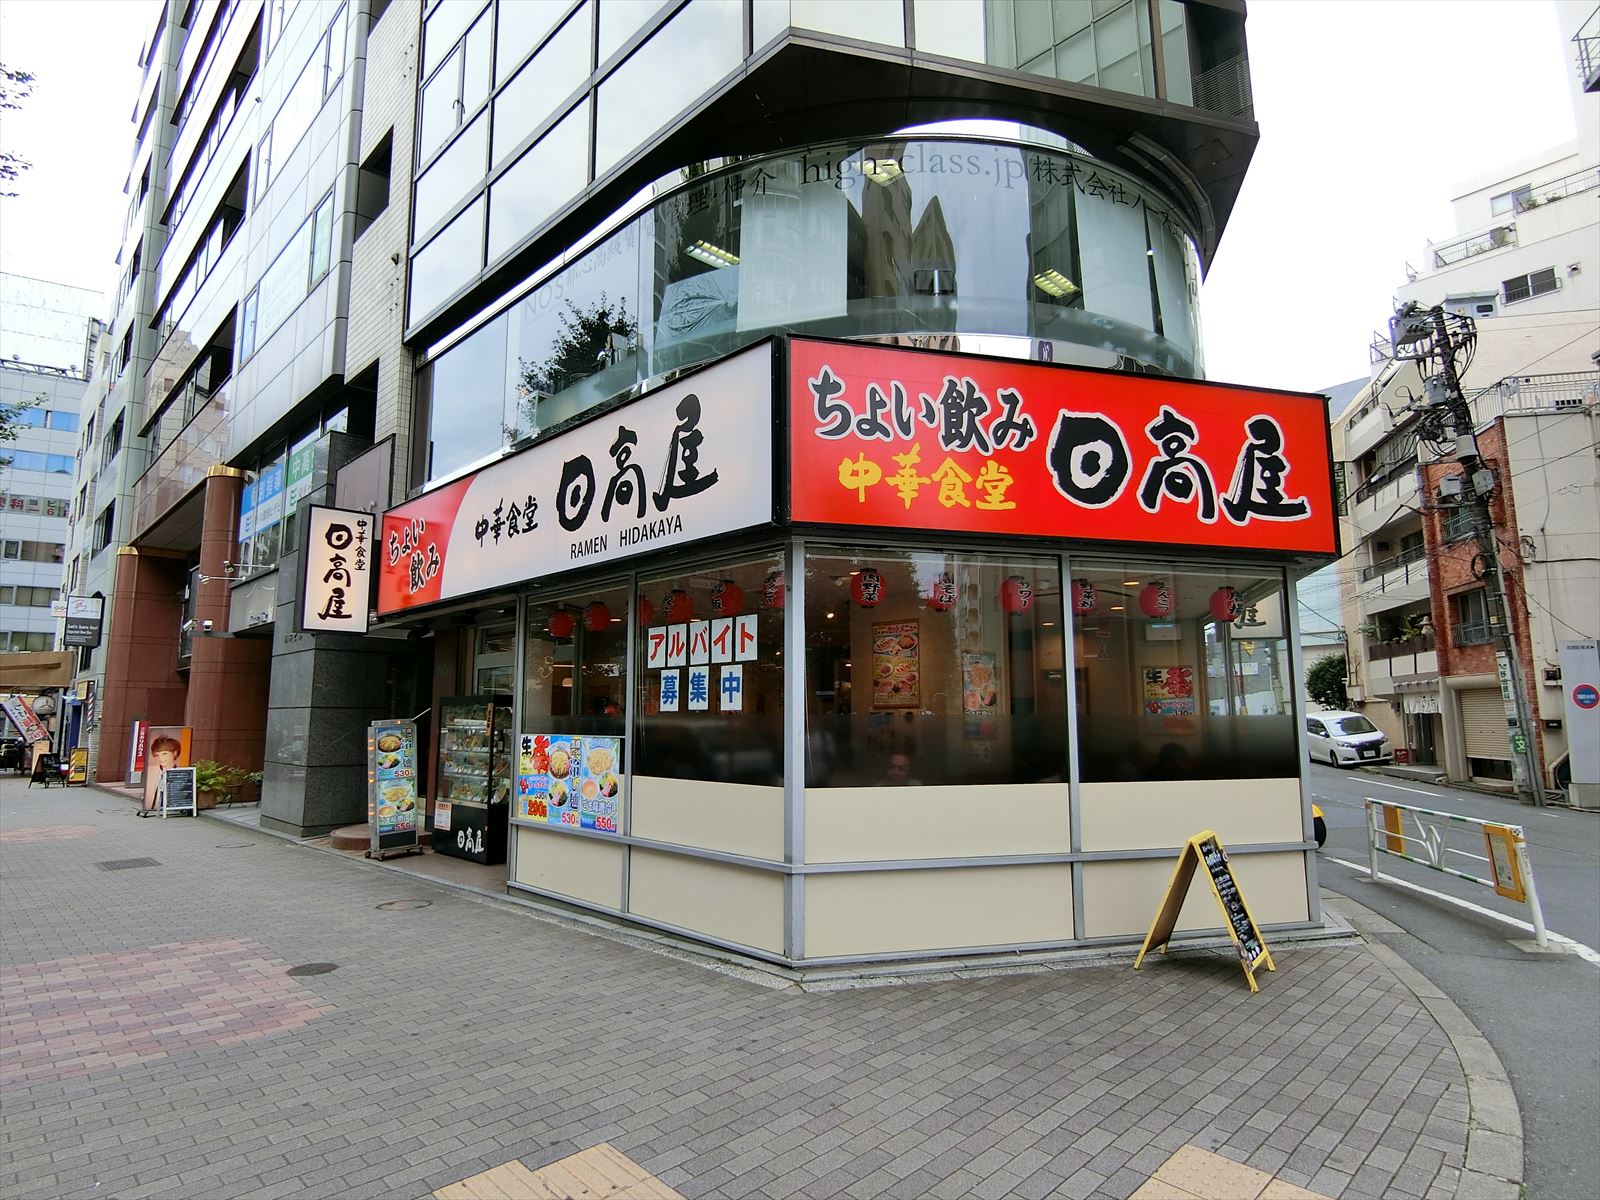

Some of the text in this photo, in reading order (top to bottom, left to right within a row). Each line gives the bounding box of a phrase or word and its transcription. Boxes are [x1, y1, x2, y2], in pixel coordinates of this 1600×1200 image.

[801, 142, 1024, 190] high-class.jp
[807, 364, 1037, 455] ちょい飲み
[556, 393, 719, 531] 日高屋
[838, 443, 1016, 510] 中華食堂
[1046, 404, 1311, 526] 日高屋
[355, 519, 368, 571] 中華食堂
[474, 495, 539, 548] 中華食堂
[570, 514, 683, 560] RAMEN HIDAKAYA
[318, 523, 353, 620] 日高屋
[409, 543, 441, 594] 飲み
[649, 623, 755, 661] アルバイト
[661, 671, 741, 705] 募集中
[457, 826, 485, 854] 日高屋
